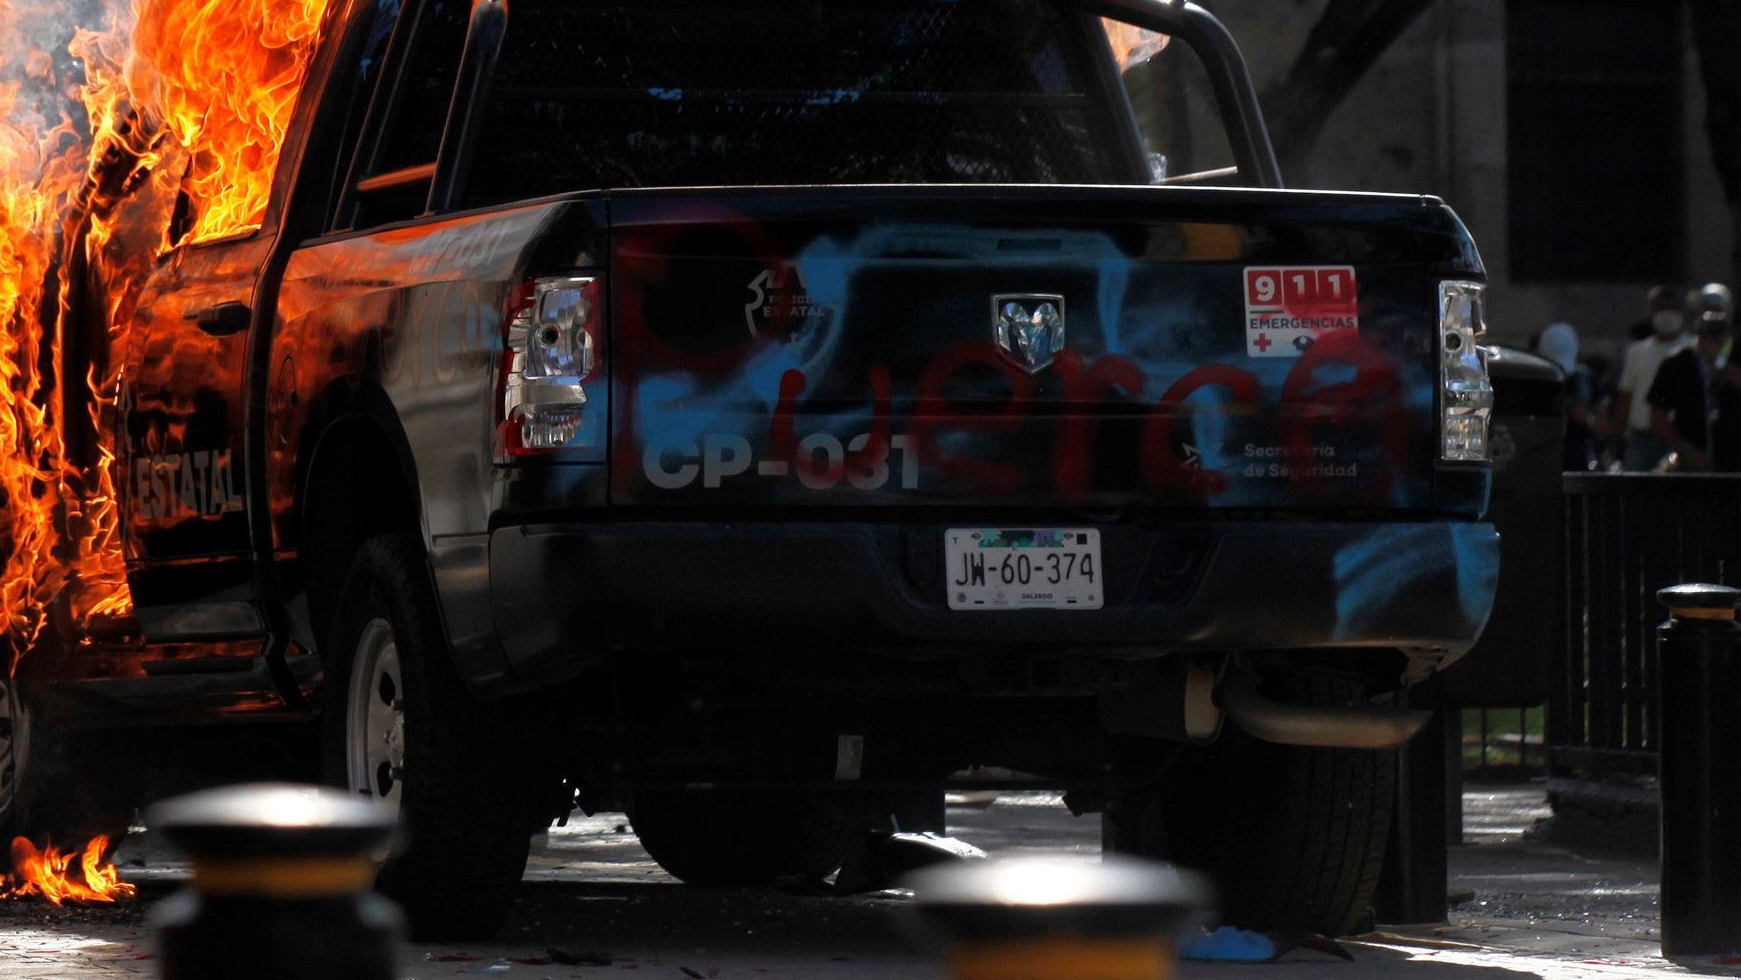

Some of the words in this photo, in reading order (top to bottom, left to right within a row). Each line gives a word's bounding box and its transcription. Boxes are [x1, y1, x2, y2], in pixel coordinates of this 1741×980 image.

[1255, 274, 1341, 302] 911
[763, 305, 826, 317] ESATAL
[1250, 317, 1355, 329] EMERGENCIAS
[642, 432, 919, 490] CP-031
[1243, 463, 1265, 478] de
[136, 448, 243, 519] ESTATAL
[956, 553, 1094, 587] JW-60-374
